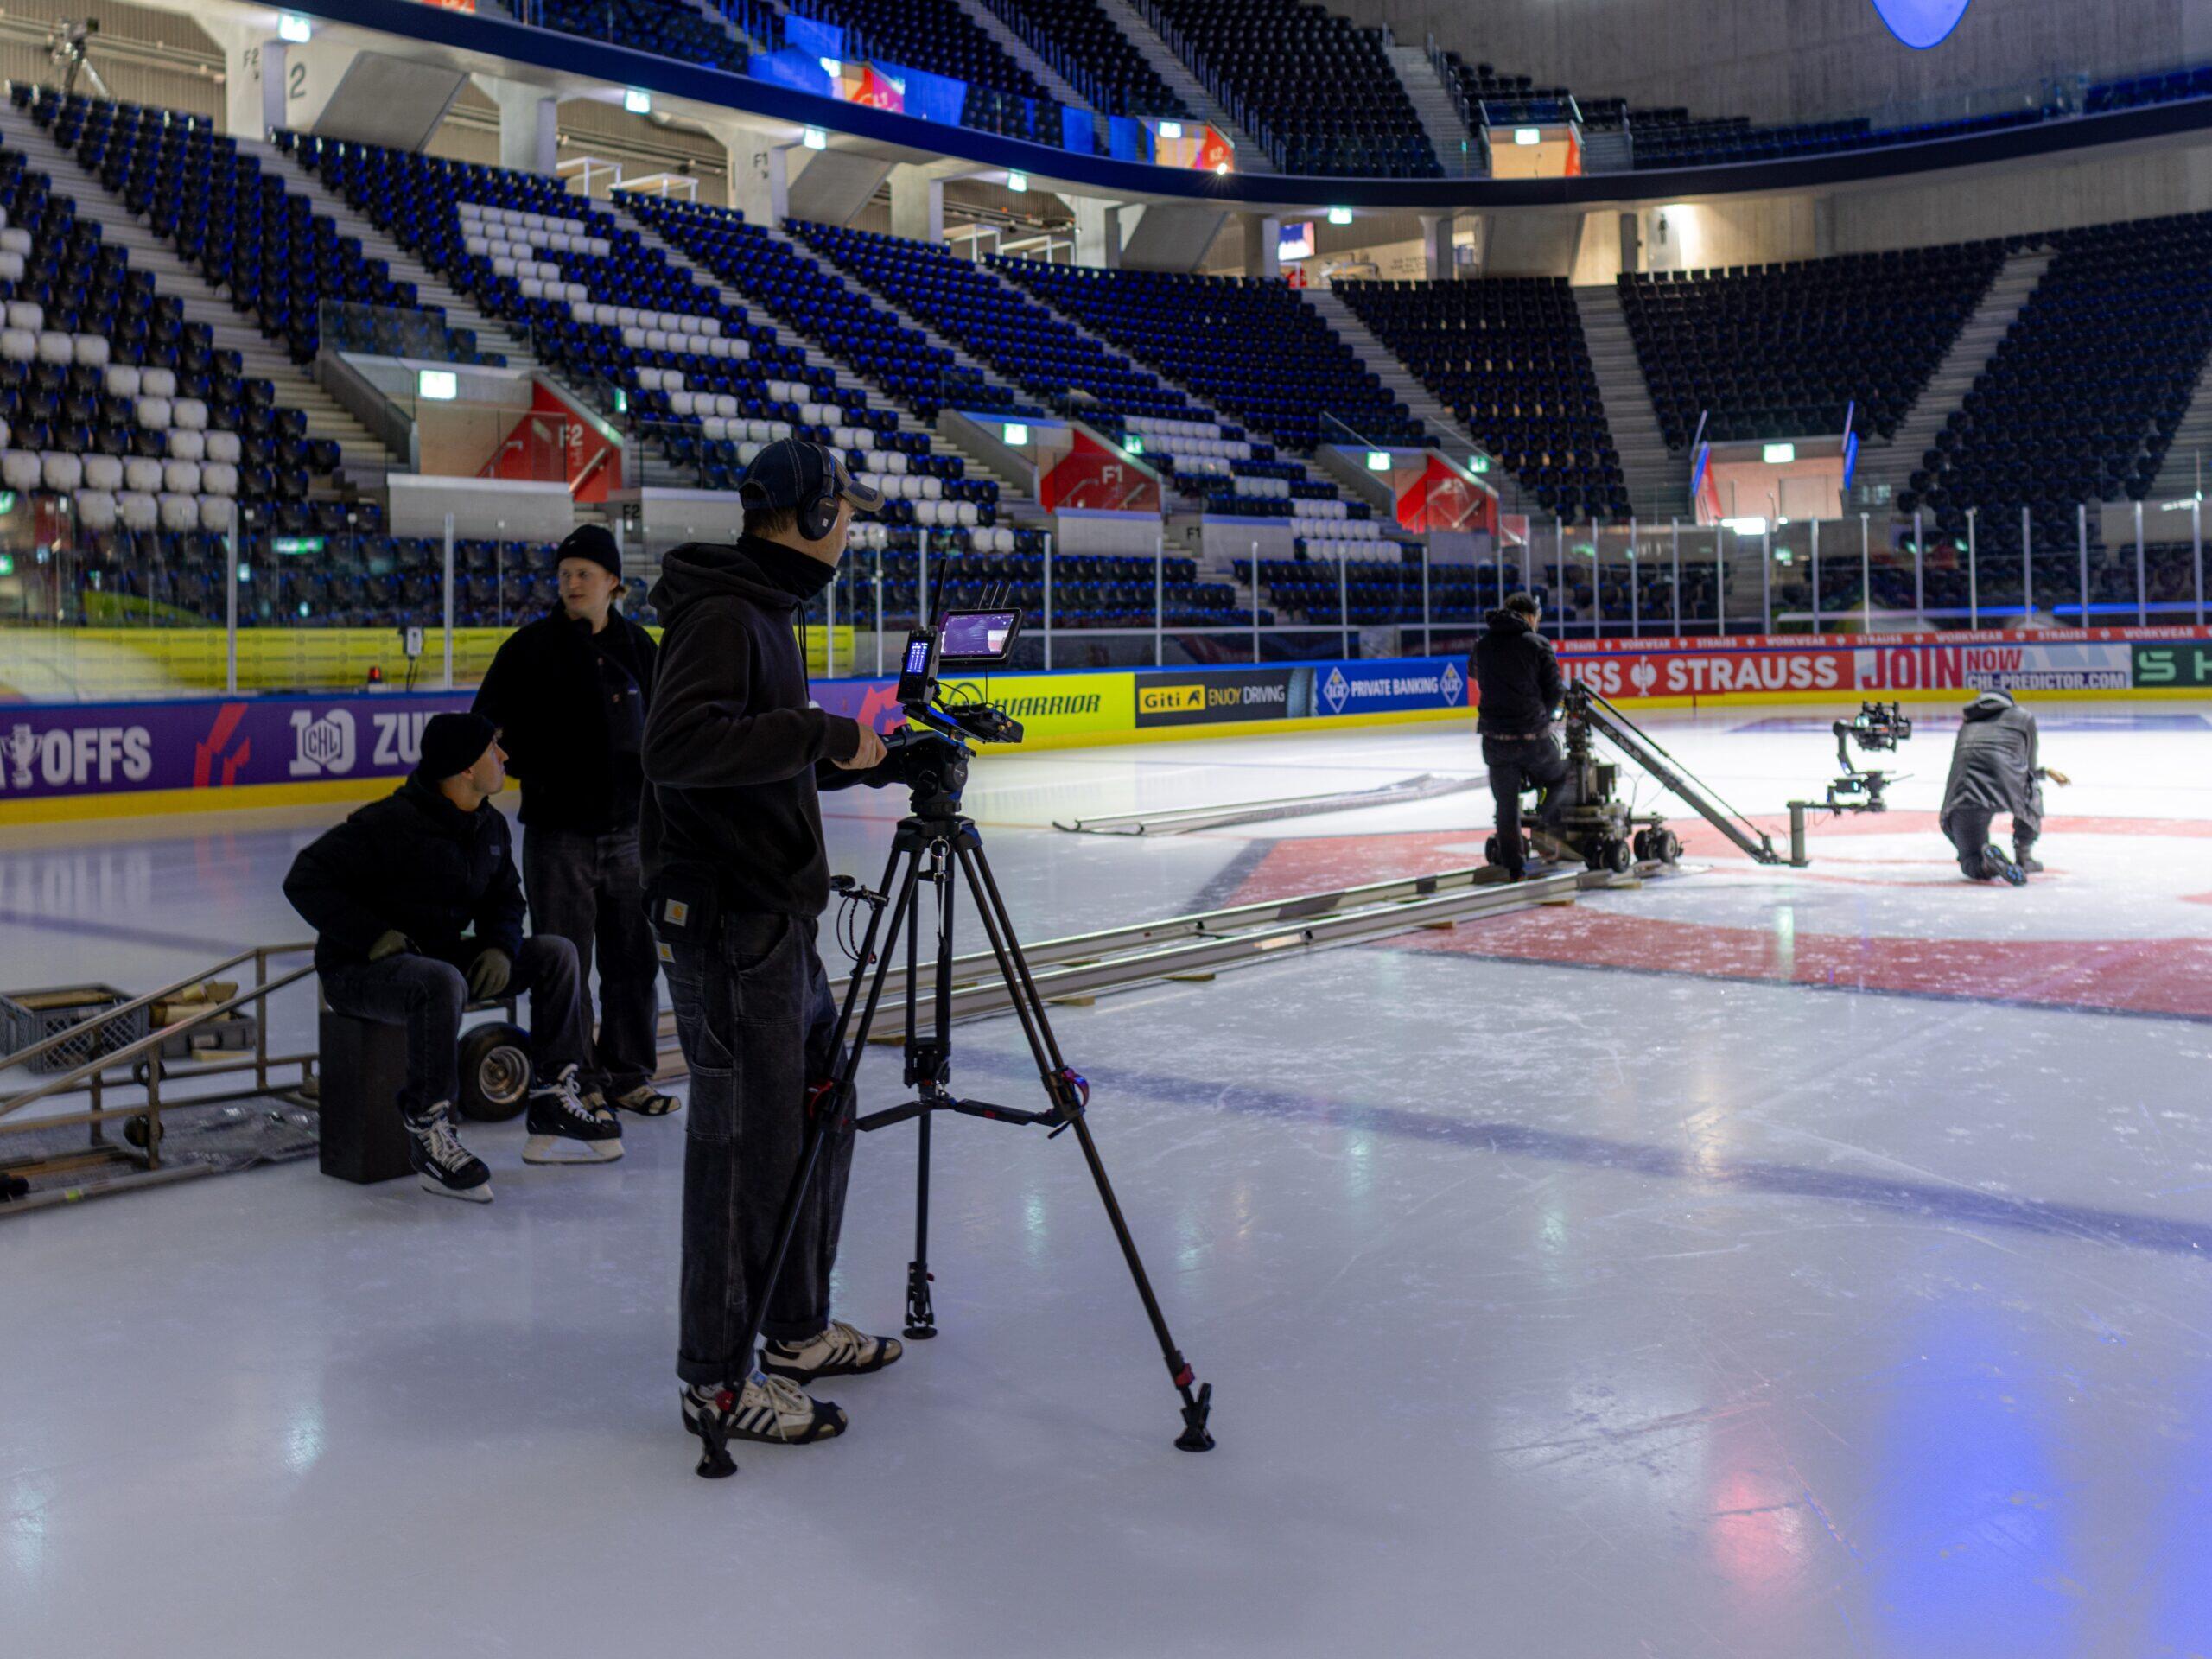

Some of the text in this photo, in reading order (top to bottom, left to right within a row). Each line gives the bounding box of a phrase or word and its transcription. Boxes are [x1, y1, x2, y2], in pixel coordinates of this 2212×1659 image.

[289, 62, 306, 99] 2
[559, 423, 583, 448] F2
[1103, 465, 1122, 484] F1
[623, 503, 640, 520] F2
[1187, 526, 1201, 540] F1
[1565, 627, 2195, 652] STRAUSS WORKWEAR STRAUSS WORKWEAR STRAUSS WORKWEAR STRAUSS WORKWEAR
[1862, 647, 1962, 690] JOIN
[1967, 649, 2023, 671] NOW
[1666, 655, 1839, 691] STRAUSS
[1967, 671, 2126, 690] CHL-PREDICTOR.COM
[1209, 685, 1285, 706] ENJOY DRIVING
[1351, 677, 1440, 697] PRIVATE BANKING
[1144, 692, 1180, 709] Giti
[308, 725, 340, 758] CHL
